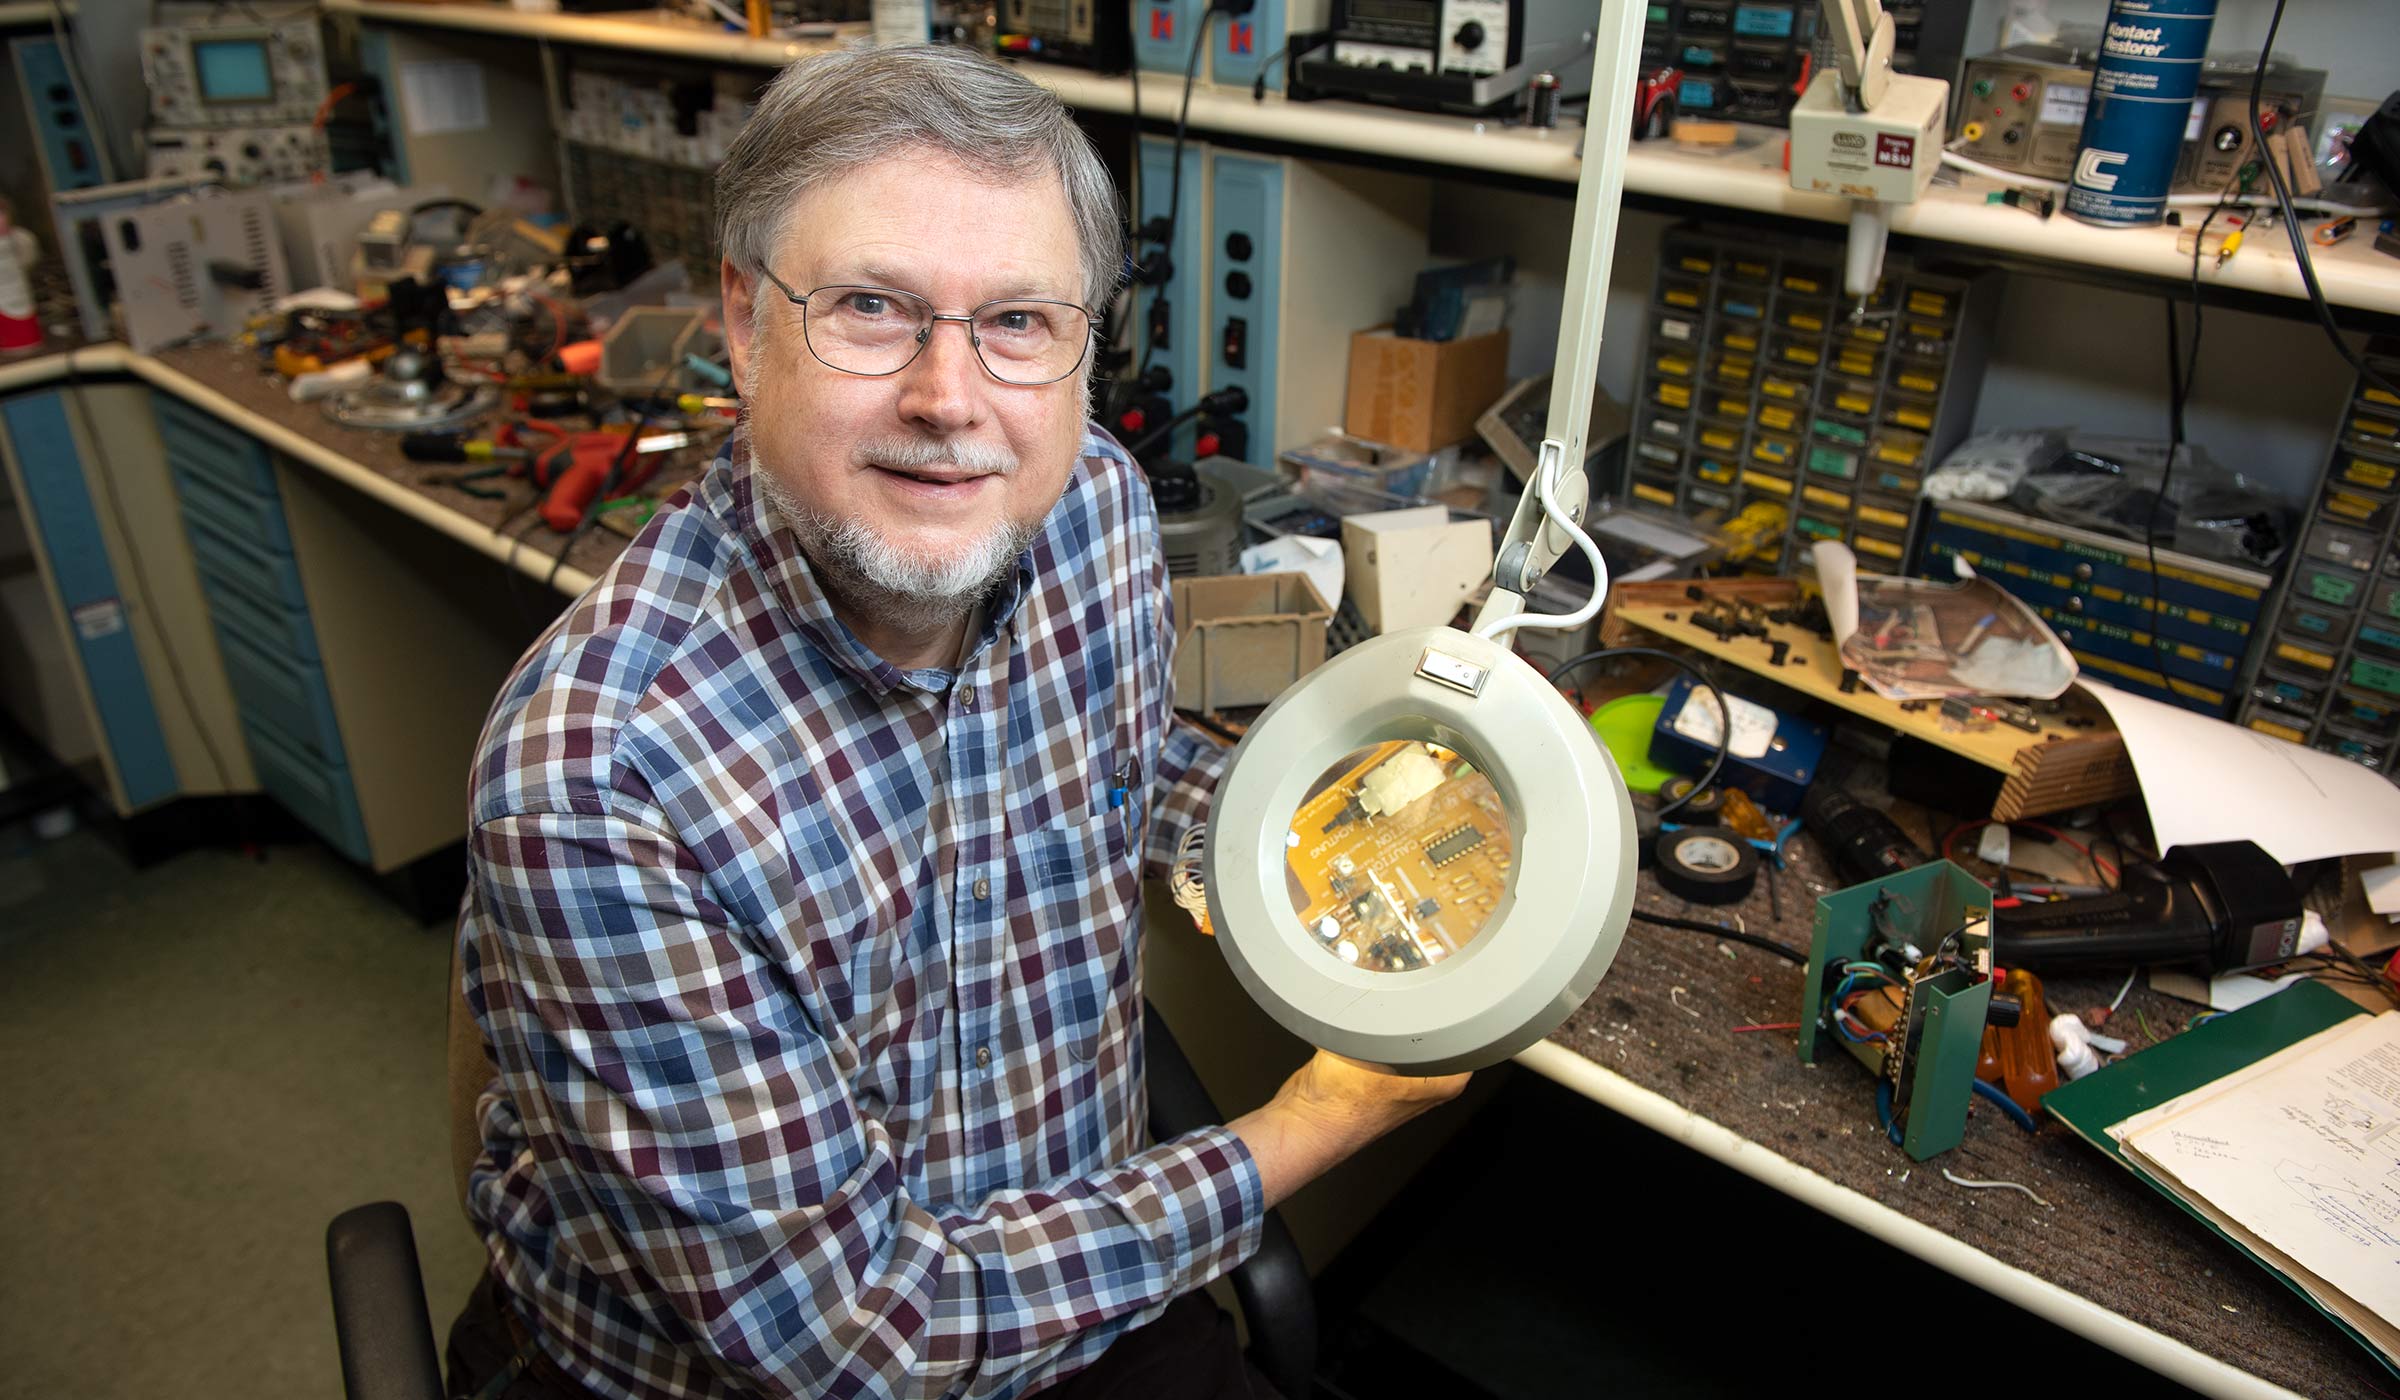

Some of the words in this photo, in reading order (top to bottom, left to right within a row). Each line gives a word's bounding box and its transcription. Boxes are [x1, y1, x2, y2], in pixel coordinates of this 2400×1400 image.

[2107, 22, 2162, 42] Kontact
[1878, 151, 1911, 166] MSU
[1310, 822, 1355, 860] ACHTUNG
